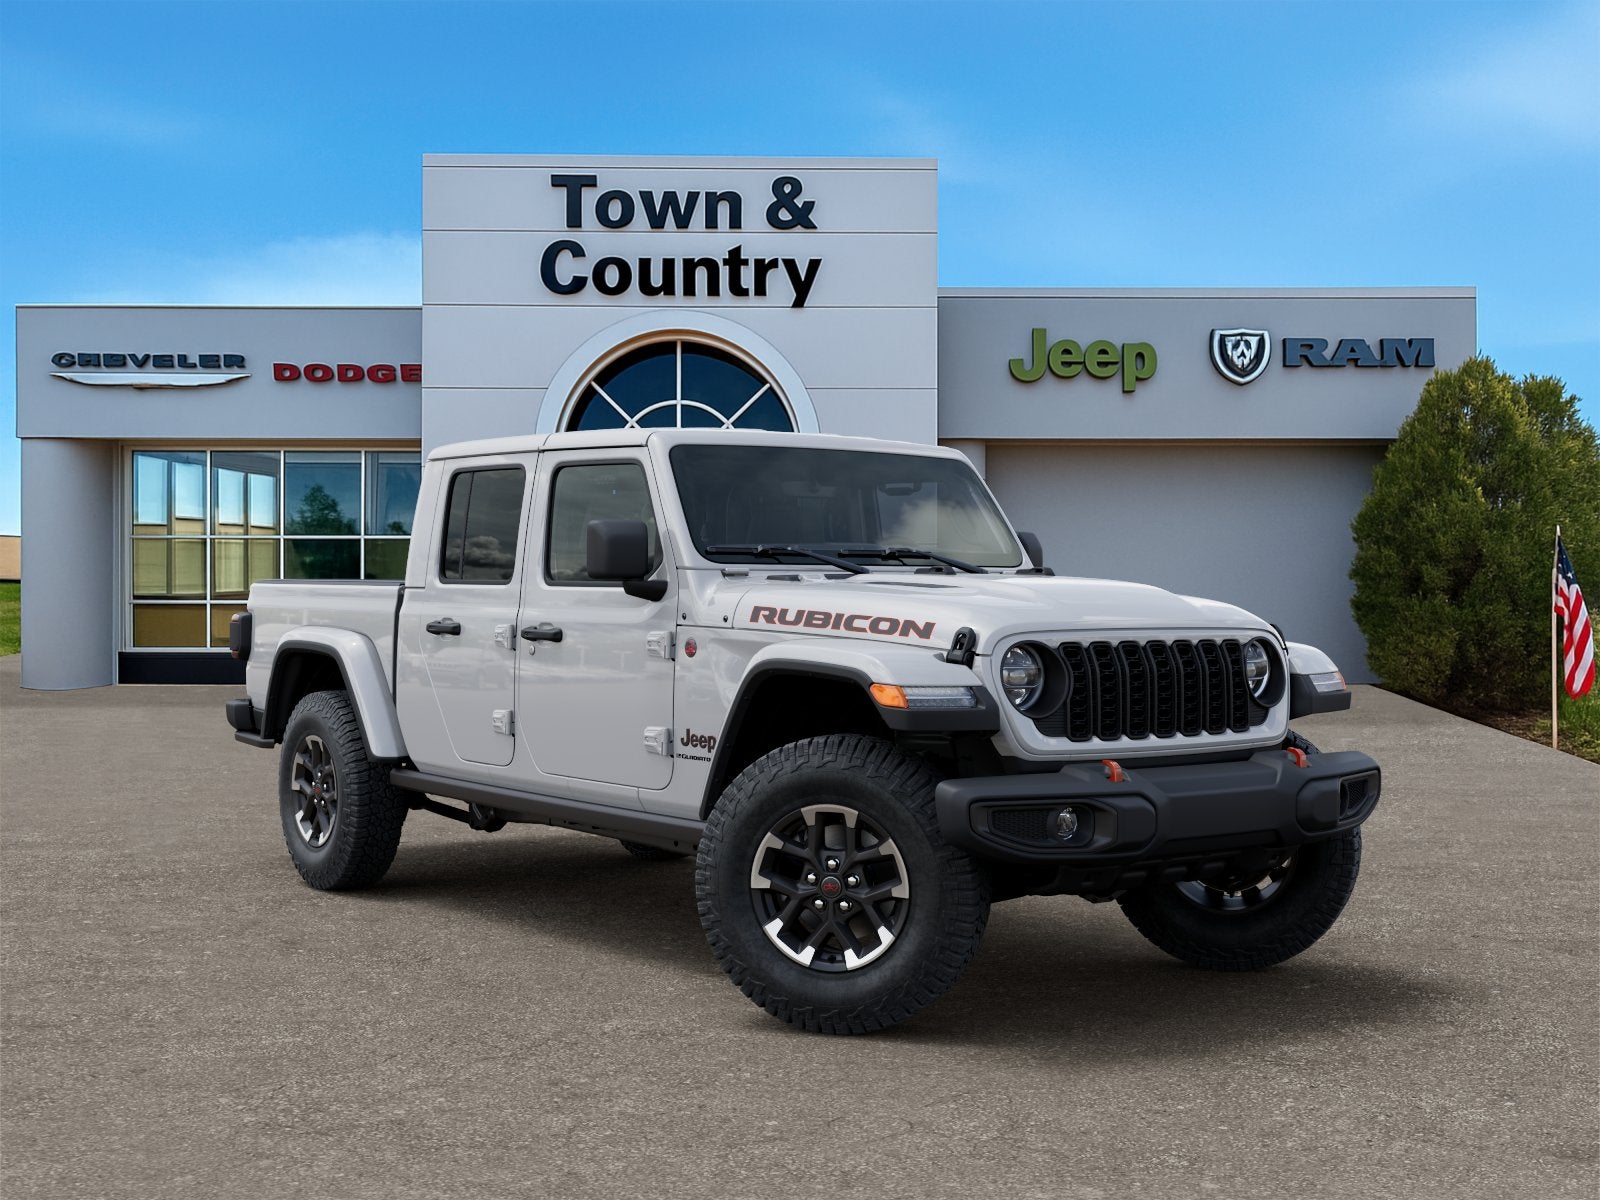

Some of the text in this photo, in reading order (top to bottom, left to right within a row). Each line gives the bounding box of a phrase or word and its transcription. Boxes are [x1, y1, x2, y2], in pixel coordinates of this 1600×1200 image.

[551, 174, 817, 230] Town &
[540, 240, 822, 308] Country
[1009, 328, 1157, 393] Jeep
[1283, 338, 1435, 367] RAM
[273, 363, 422, 382] DODGE
[750, 605, 936, 639] RUBICON
[681, 729, 716, 753] Jeep
